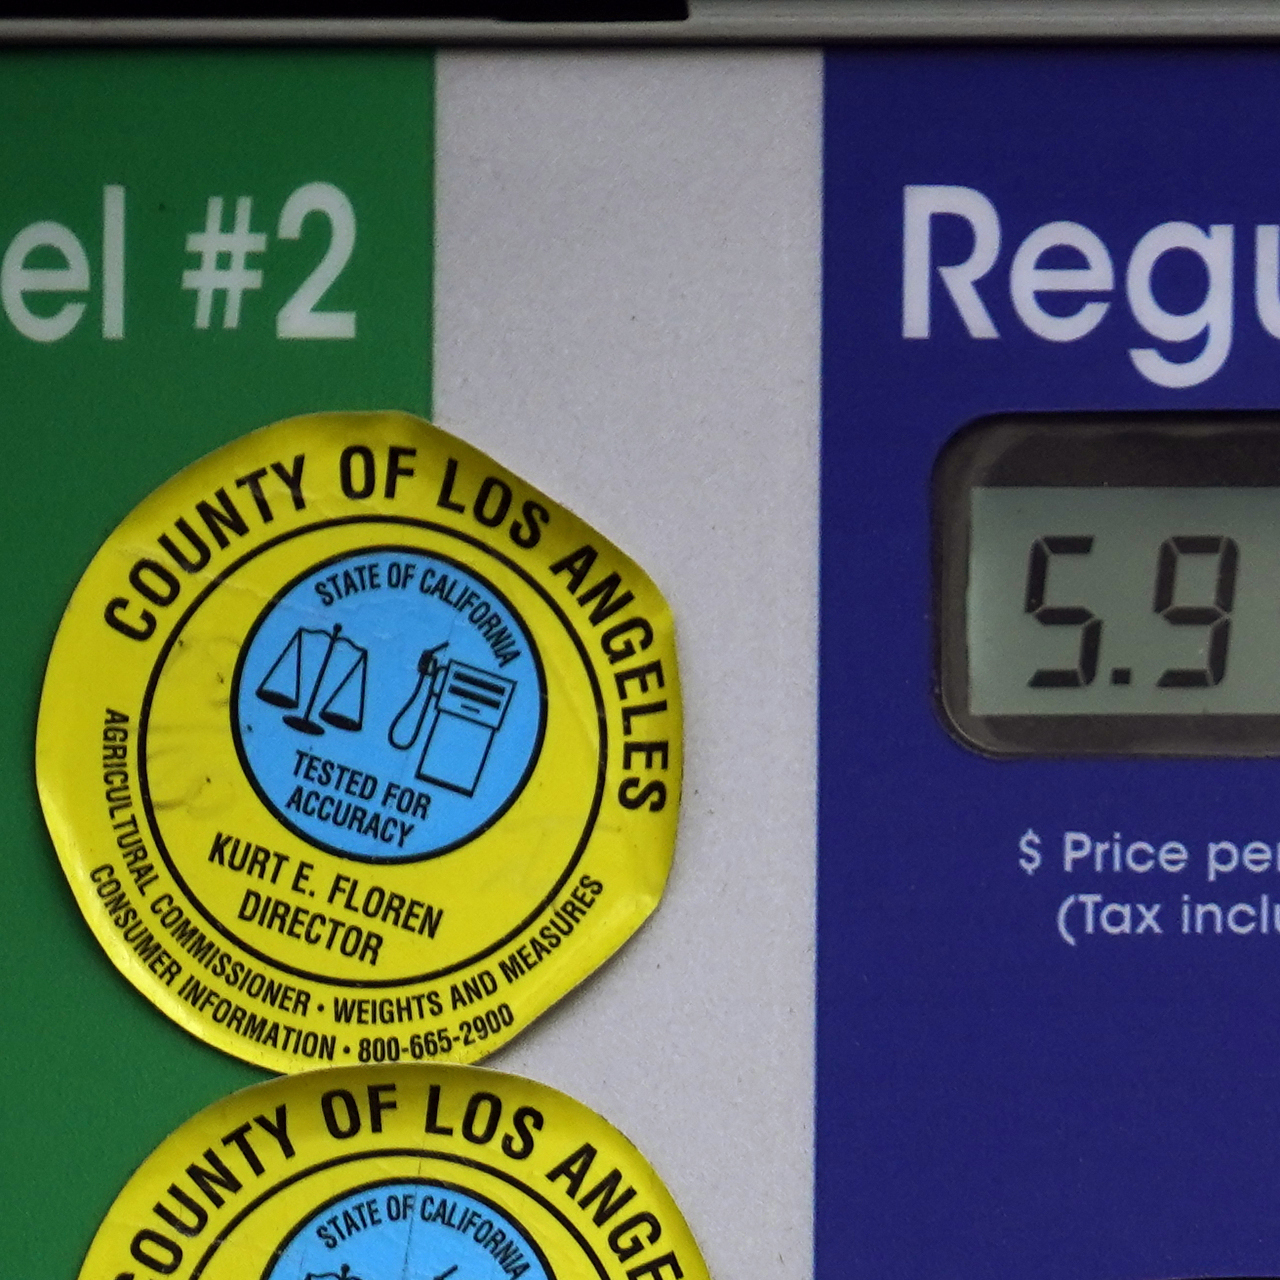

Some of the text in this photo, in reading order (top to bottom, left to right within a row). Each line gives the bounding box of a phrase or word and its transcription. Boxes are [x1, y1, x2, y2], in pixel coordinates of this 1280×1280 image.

[182, 180, 358, 339] #2
[105, 445, 670, 815] COUNTY OF LOS ANGELES
[314, 563, 524, 669] STATE OF CALIFORNIA
[285, 789, 415, 849] ACCURACY
[294, 750, 432, 821] TESTED FOR
[104, 707, 157, 896] AGRICULTURAL
[152, 893, 313, 1018] COMMISSIONER
[333, 993, 444, 1027] WEIGHTS
[450, 973, 501, 1013] AND
[501, 872, 605, 985] MEASURES
[208, 832, 444, 939] KURT E. FLOREN
[1019, 830, 1042, 875] $
[1063, 833, 1189, 873] Price
[238, 889, 385, 966] DIRECTOR
[1058, 895, 1162, 945] (Tax
[89, 861, 516, 1065] CONSUMER INFORMATION 800-665-2900
[321, 1083, 399, 1140] OF
[425, 1084, 545, 1163] LOS
[316, 1203, 380, 1249] STATE
[386, 1196, 414, 1223] OF
